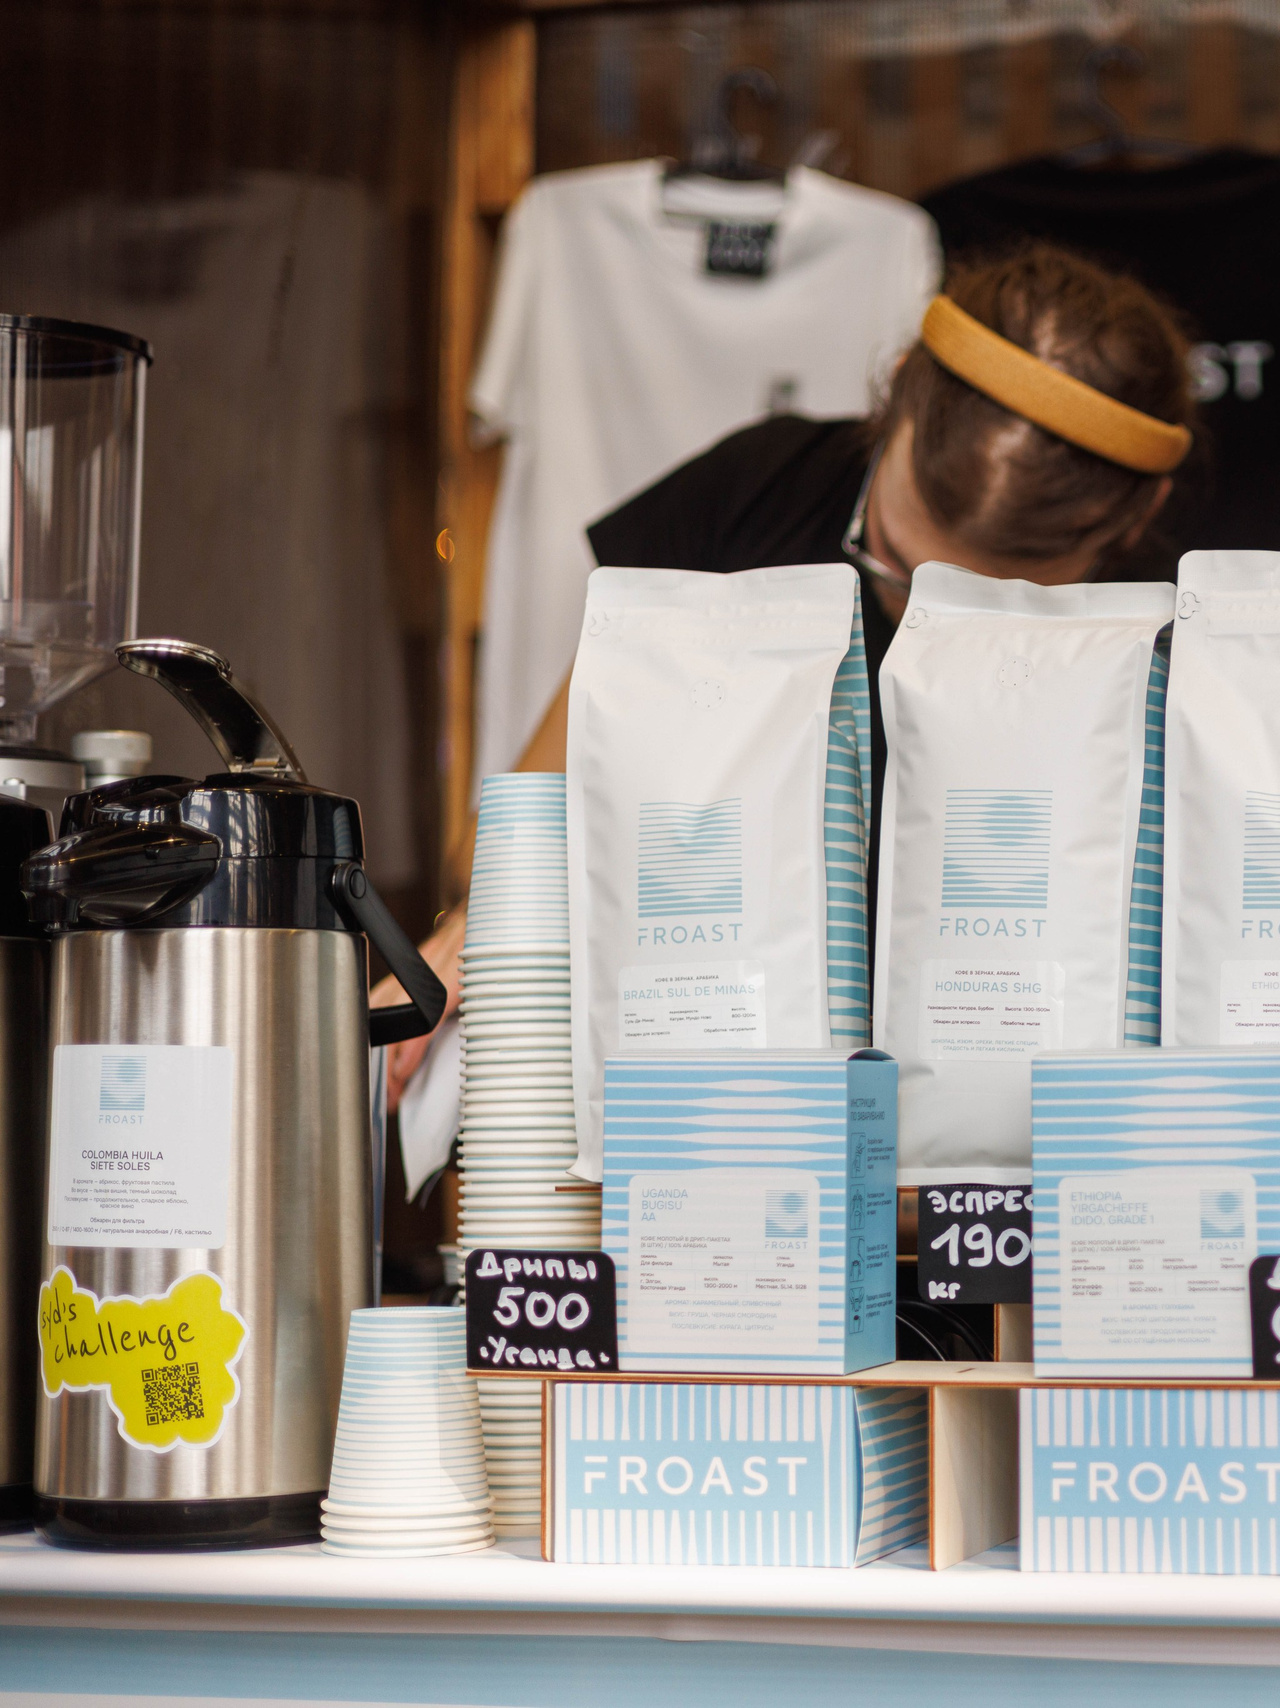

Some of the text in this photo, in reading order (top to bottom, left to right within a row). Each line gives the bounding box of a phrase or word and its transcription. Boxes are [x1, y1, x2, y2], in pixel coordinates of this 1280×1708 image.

[939, 917, 1046, 938] FROAST
[638, 923, 743, 946] FROAST
[623, 984, 756, 1001] BRAZIL SUL DE MINAS
[935, 981, 1042, 994] HONDURAS SHG
[98, 1114, 144, 1125] FROAST
[81, 1150, 164, 1161] COLOMBIA HUILA
[90, 1161, 150, 1171] SIETE SOLES
[641, 1188, 688, 1199] UGANDA
[1070, 1191, 1122, 1202] ETHIOPIA
[641, 1200, 683, 1211] BUGISU
[1070, 1202, 1149, 1214] YIRGACHEFFE
[641, 1212, 656, 1222] AA
[1070, 1214, 1155, 1226] IDIDO, GRADE 1
[764, 1240, 808, 1250] FROAST
[930, 1223, 1033, 1267] 190
[1200, 1241, 1246, 1251] FROAST
[476, 1252, 597, 1282] Дрипы
[928, 1280, 961, 1300] кг
[493, 1286, 590, 1330] 500
[54, 1319, 196, 1364] challenge
[583, 1455, 808, 1496] FROAST
